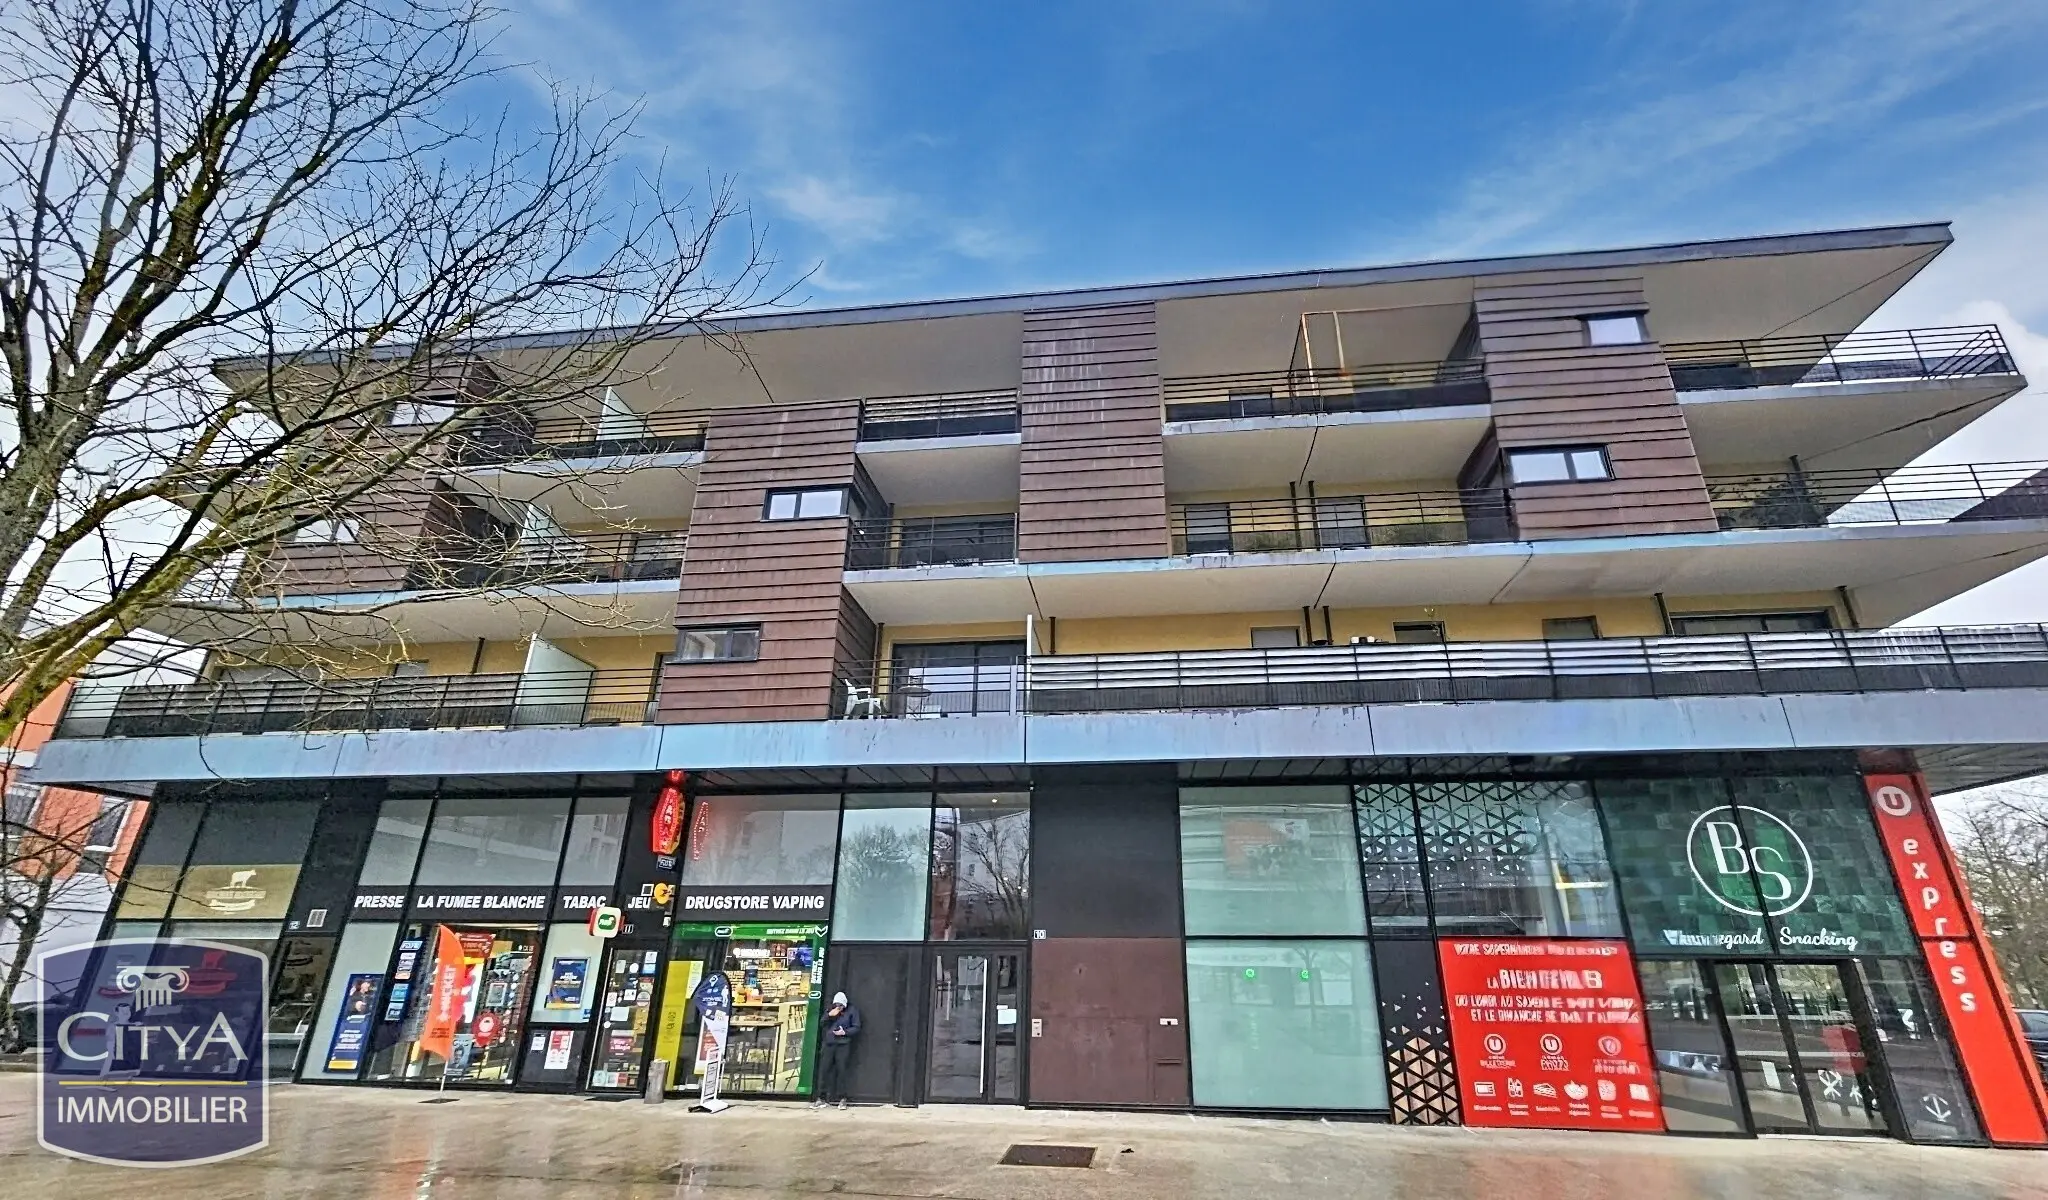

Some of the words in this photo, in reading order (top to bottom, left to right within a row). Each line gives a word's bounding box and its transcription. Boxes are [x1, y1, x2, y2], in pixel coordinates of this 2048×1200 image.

[1706, 821, 1792, 900] BS
[354, 895, 405, 908] PRESSE
[417, 895, 434, 909] LA
[436, 896, 481, 909] FUMEE
[483, 896, 545, 909] BLANCHE
[563, 895, 606, 909] TABAC
[685, 895, 772, 909] DRUGSTORE
[773, 895, 825, 909] VAPING
[1903, 838, 1977, 1012] express
[1779, 926, 1858, 951] Snacking
[1471, 1009, 1482, 1022] ET
[1485, 1009, 1497, 1022] LE
